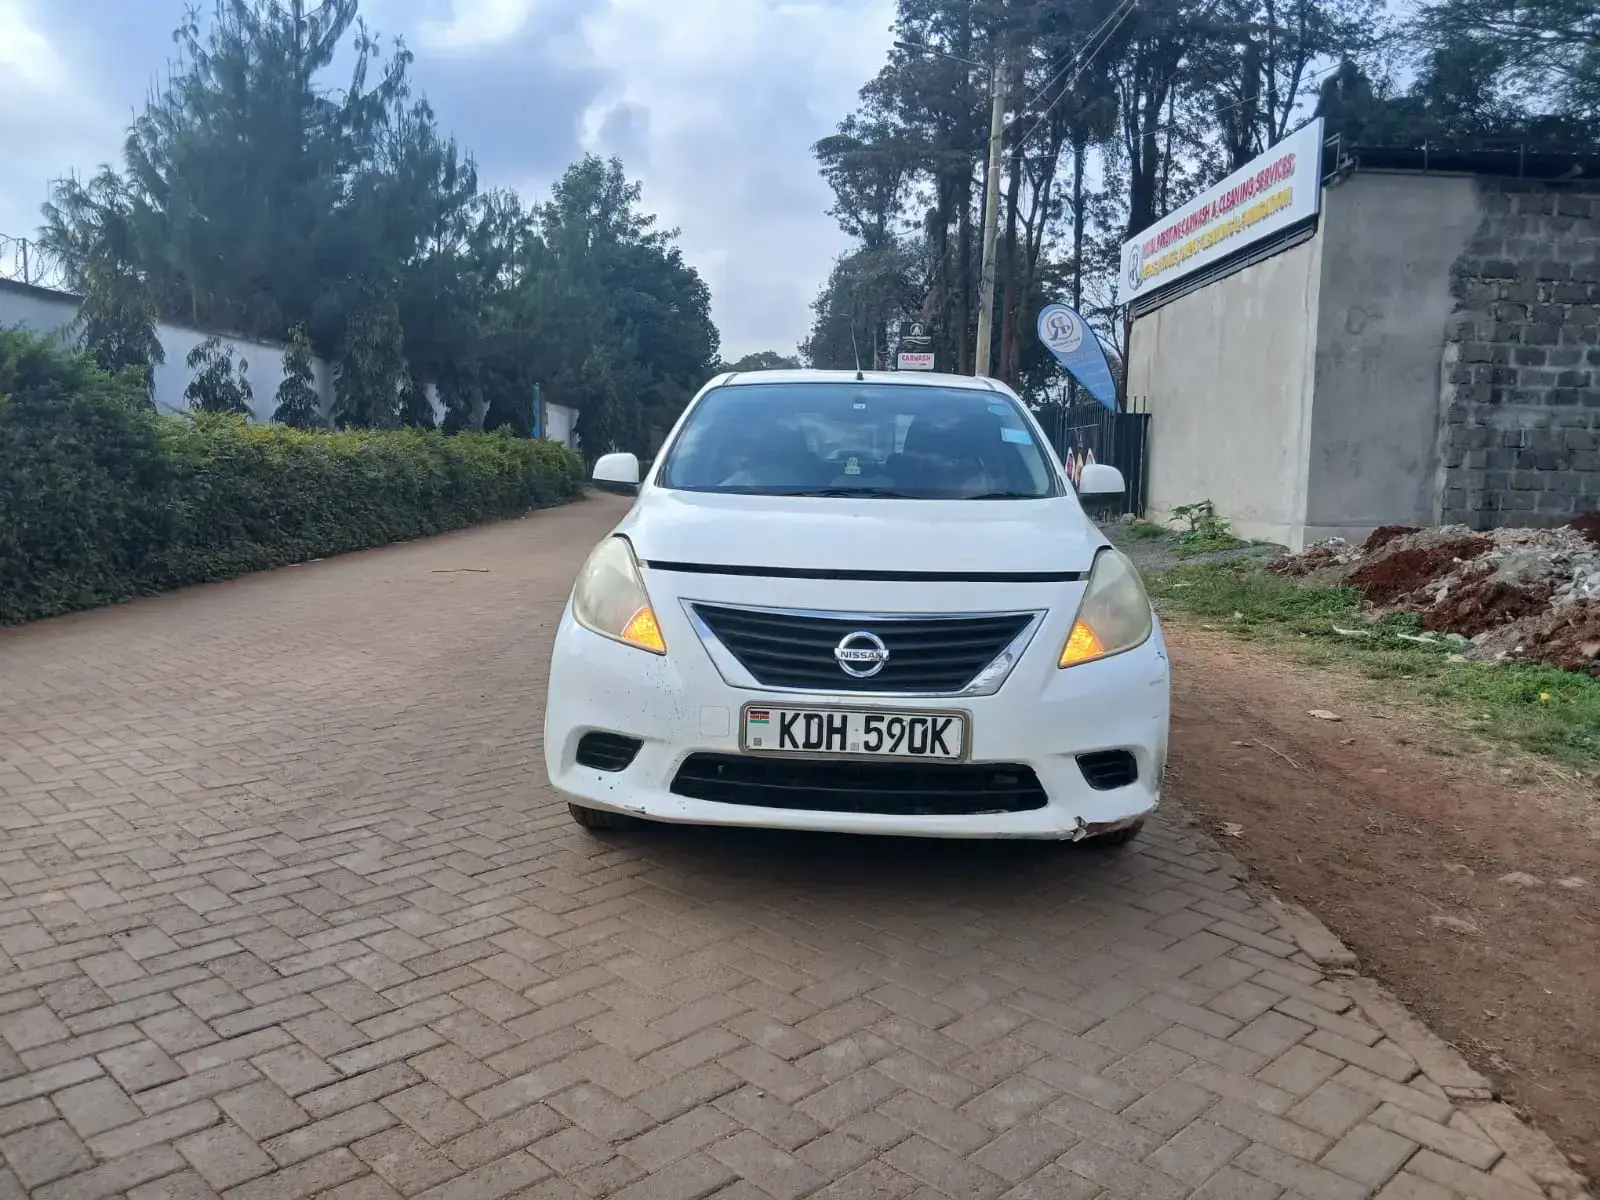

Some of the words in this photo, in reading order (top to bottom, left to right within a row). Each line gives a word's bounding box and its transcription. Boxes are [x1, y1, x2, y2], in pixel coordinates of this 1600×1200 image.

[1219, 177, 1254, 213] CLEANING
[1254, 154, 1294, 191] SERVICES
[840, 650, 884, 659] NISSAN
[779, 711, 848, 751] KDH
[863, 714, 953, 755] 590K
